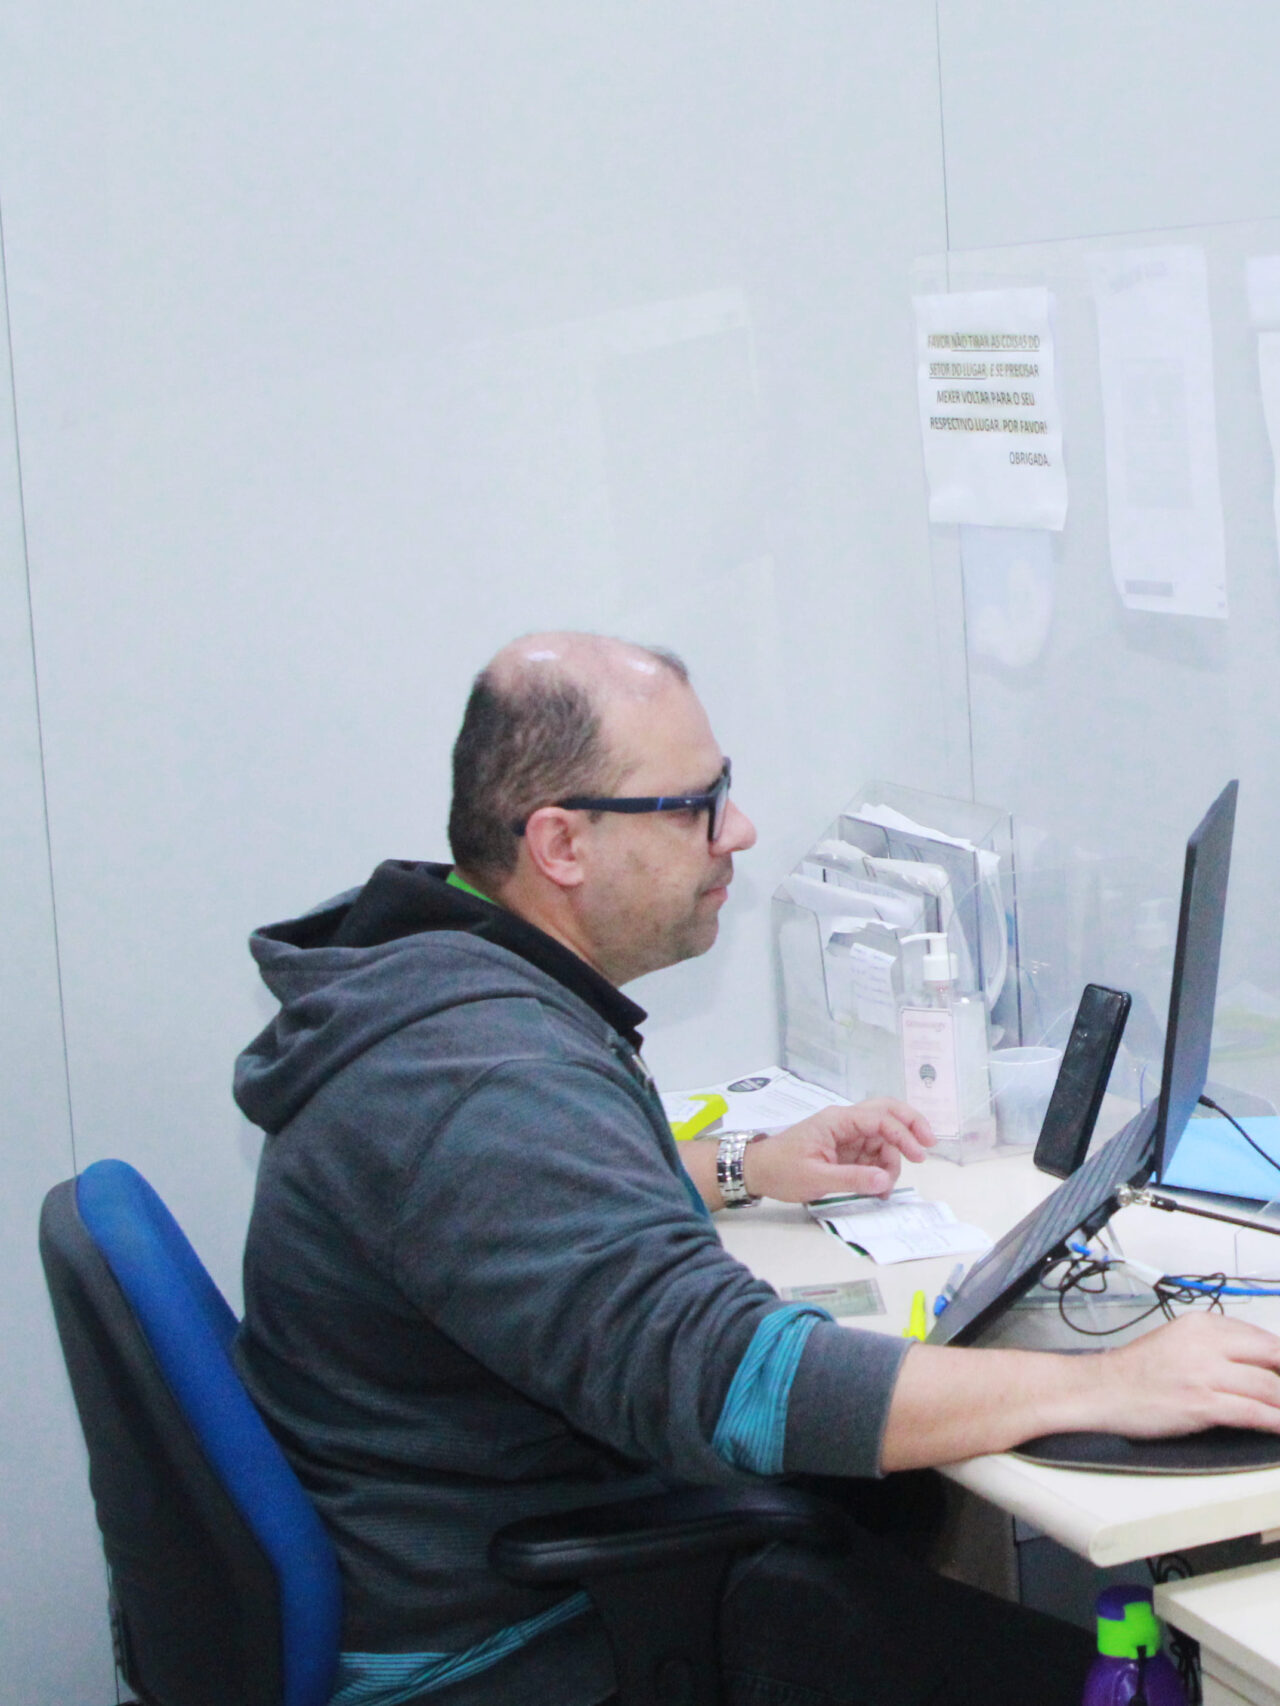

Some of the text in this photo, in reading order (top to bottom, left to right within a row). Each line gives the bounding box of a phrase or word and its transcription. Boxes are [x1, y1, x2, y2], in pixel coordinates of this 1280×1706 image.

[929, 362, 950, 377] SETOR
[936, 390, 960, 404] MEXER
[961, 391, 989, 405] VOLTAR
[990, 392, 1012, 406] PARA
[1013, 392, 1021, 406] O
[930, 417, 974, 431] RESPECTIVO
[1002, 419, 1018, 433] POR
